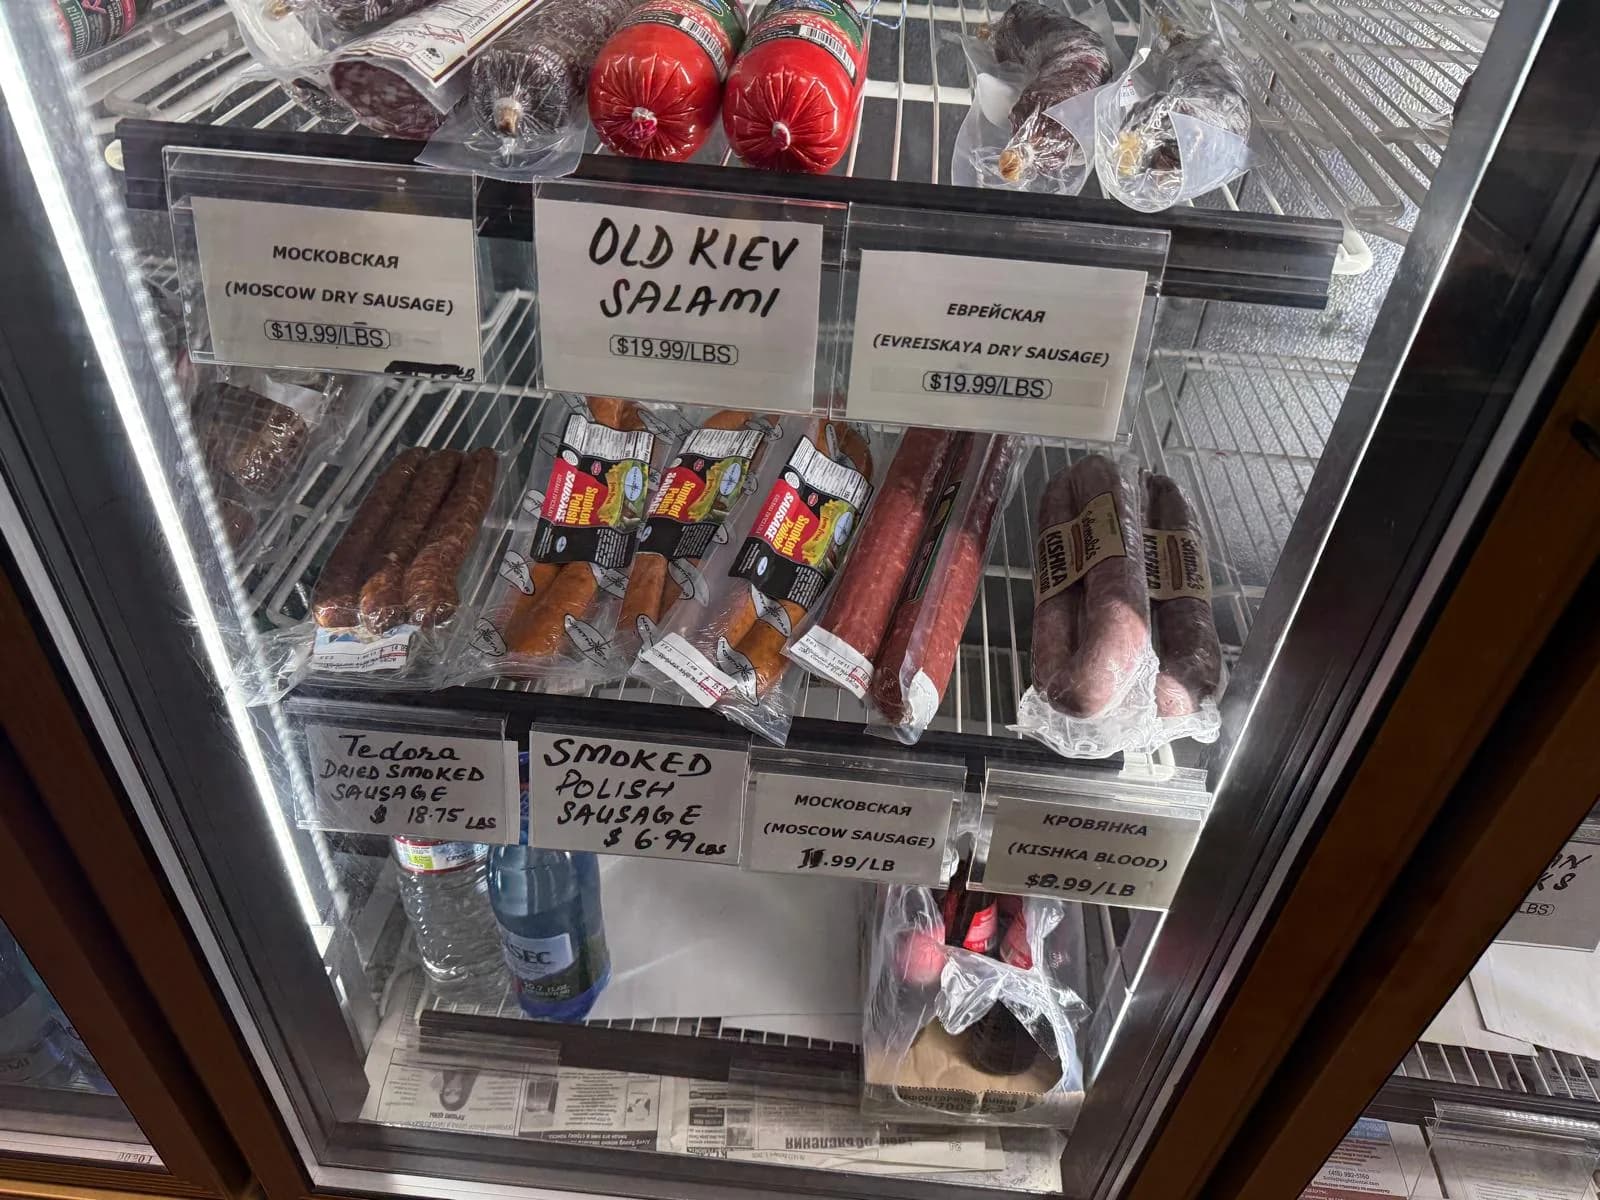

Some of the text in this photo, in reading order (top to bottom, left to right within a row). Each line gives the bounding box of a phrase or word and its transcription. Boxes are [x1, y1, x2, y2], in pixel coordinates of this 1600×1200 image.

[273, 246, 398, 268] МОСКОВСКАЯ
[589, 217, 799, 271] OLD KIEV
[225, 281, 454, 316] (MOSCOW DRY SAUSAGE)
[600, 278, 780, 318] SALAMI
[947, 303, 1045, 323] ЕВРЕЙСКАЯ
[272, 322, 384, 348] $19.99/LBS
[617, 337, 731, 364] $19.99/LBS
[873, 333, 1109, 368] (EVREISKAYA DRY SAUSAGE)
[930, 373, 1044, 398] $19.99/LBS
[556, 471, 576, 522] SAUSAGE
[565, 493, 584, 525] Polish
[579, 486, 598, 526] Smoked
[668, 480, 696, 518] Smoked
[764, 491, 795, 541] SAUSAGE
[772, 517, 795, 550] Polish
[782, 514, 810, 557] Smoked
[1047, 530, 1068, 588] KISHKA
[339, 734, 460, 761] Tedora
[544, 738, 712, 777] SMOKED
[320, 759, 484, 782] DRIED SMOKED
[556, 769, 675, 799] POLISH
[331, 784, 448, 802] SAUSAGE
[794, 794, 912, 816] МОСКОВСКАЯ
[408, 806, 464, 824] 18.75
[558, 801, 702, 826] SAUSAGE
[1042, 814, 1148, 836] КРОВЯНКА
[604, 827, 622, 848] $
[634, 828, 696, 852] 6.99
[763, 822, 936, 848] (MOSCOW SAUSAGE)
[1008, 842, 1168, 872] (KISHKA BLOOD)
